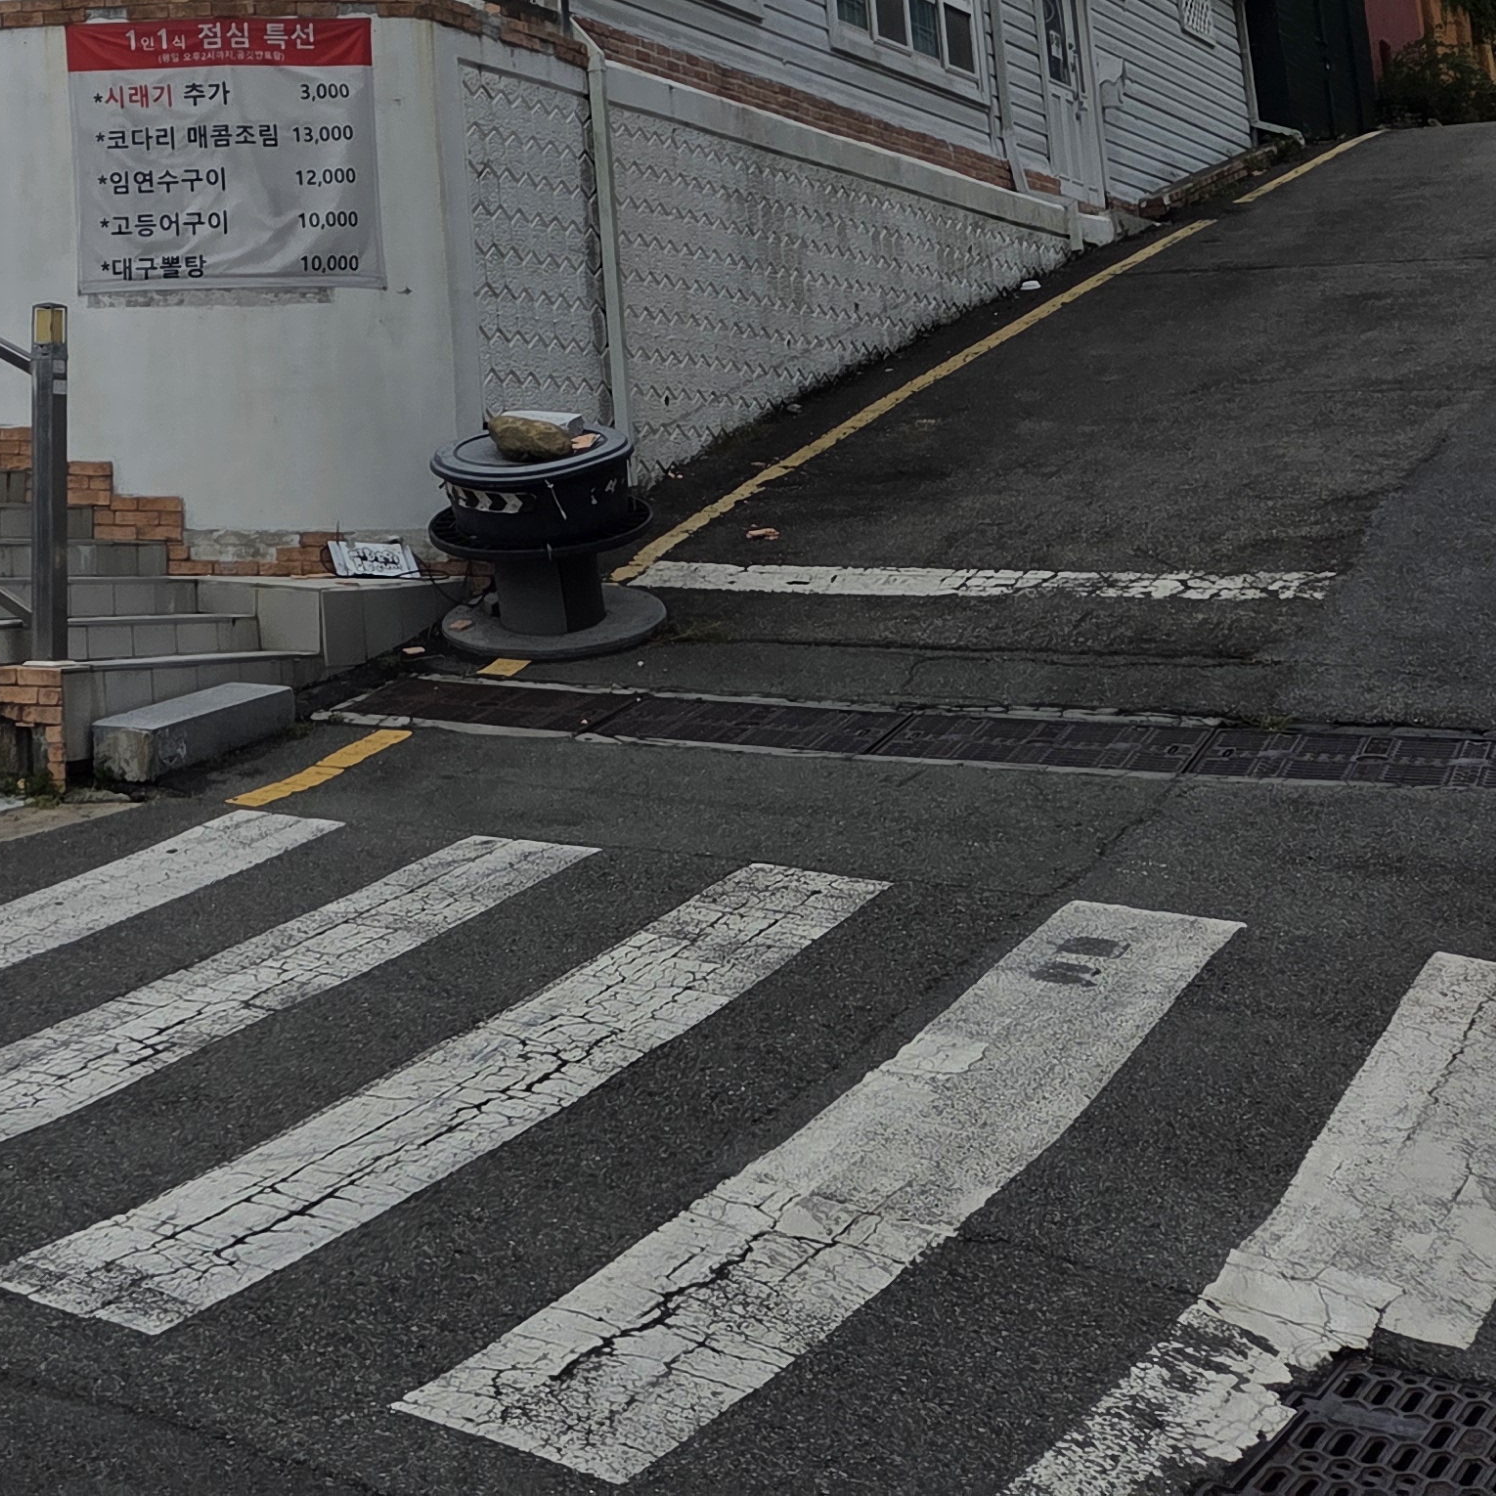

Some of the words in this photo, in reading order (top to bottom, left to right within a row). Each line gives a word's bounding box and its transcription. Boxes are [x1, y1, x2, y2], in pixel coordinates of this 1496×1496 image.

[125, 29, 186, 51] 1인1식
[197, 22, 250, 50] 점심
[263, 22, 316, 50] 특선
[183, 81, 230, 106] 추가
[300, 83, 350, 102] 3,000
[187, 124, 279, 148] 매콤조림
[292, 125, 354, 144] 13,000
[295, 167, 356, 188] 12,000
[298, 211, 358, 230] 10,000
[300, 255, 359, 275] 10,000
